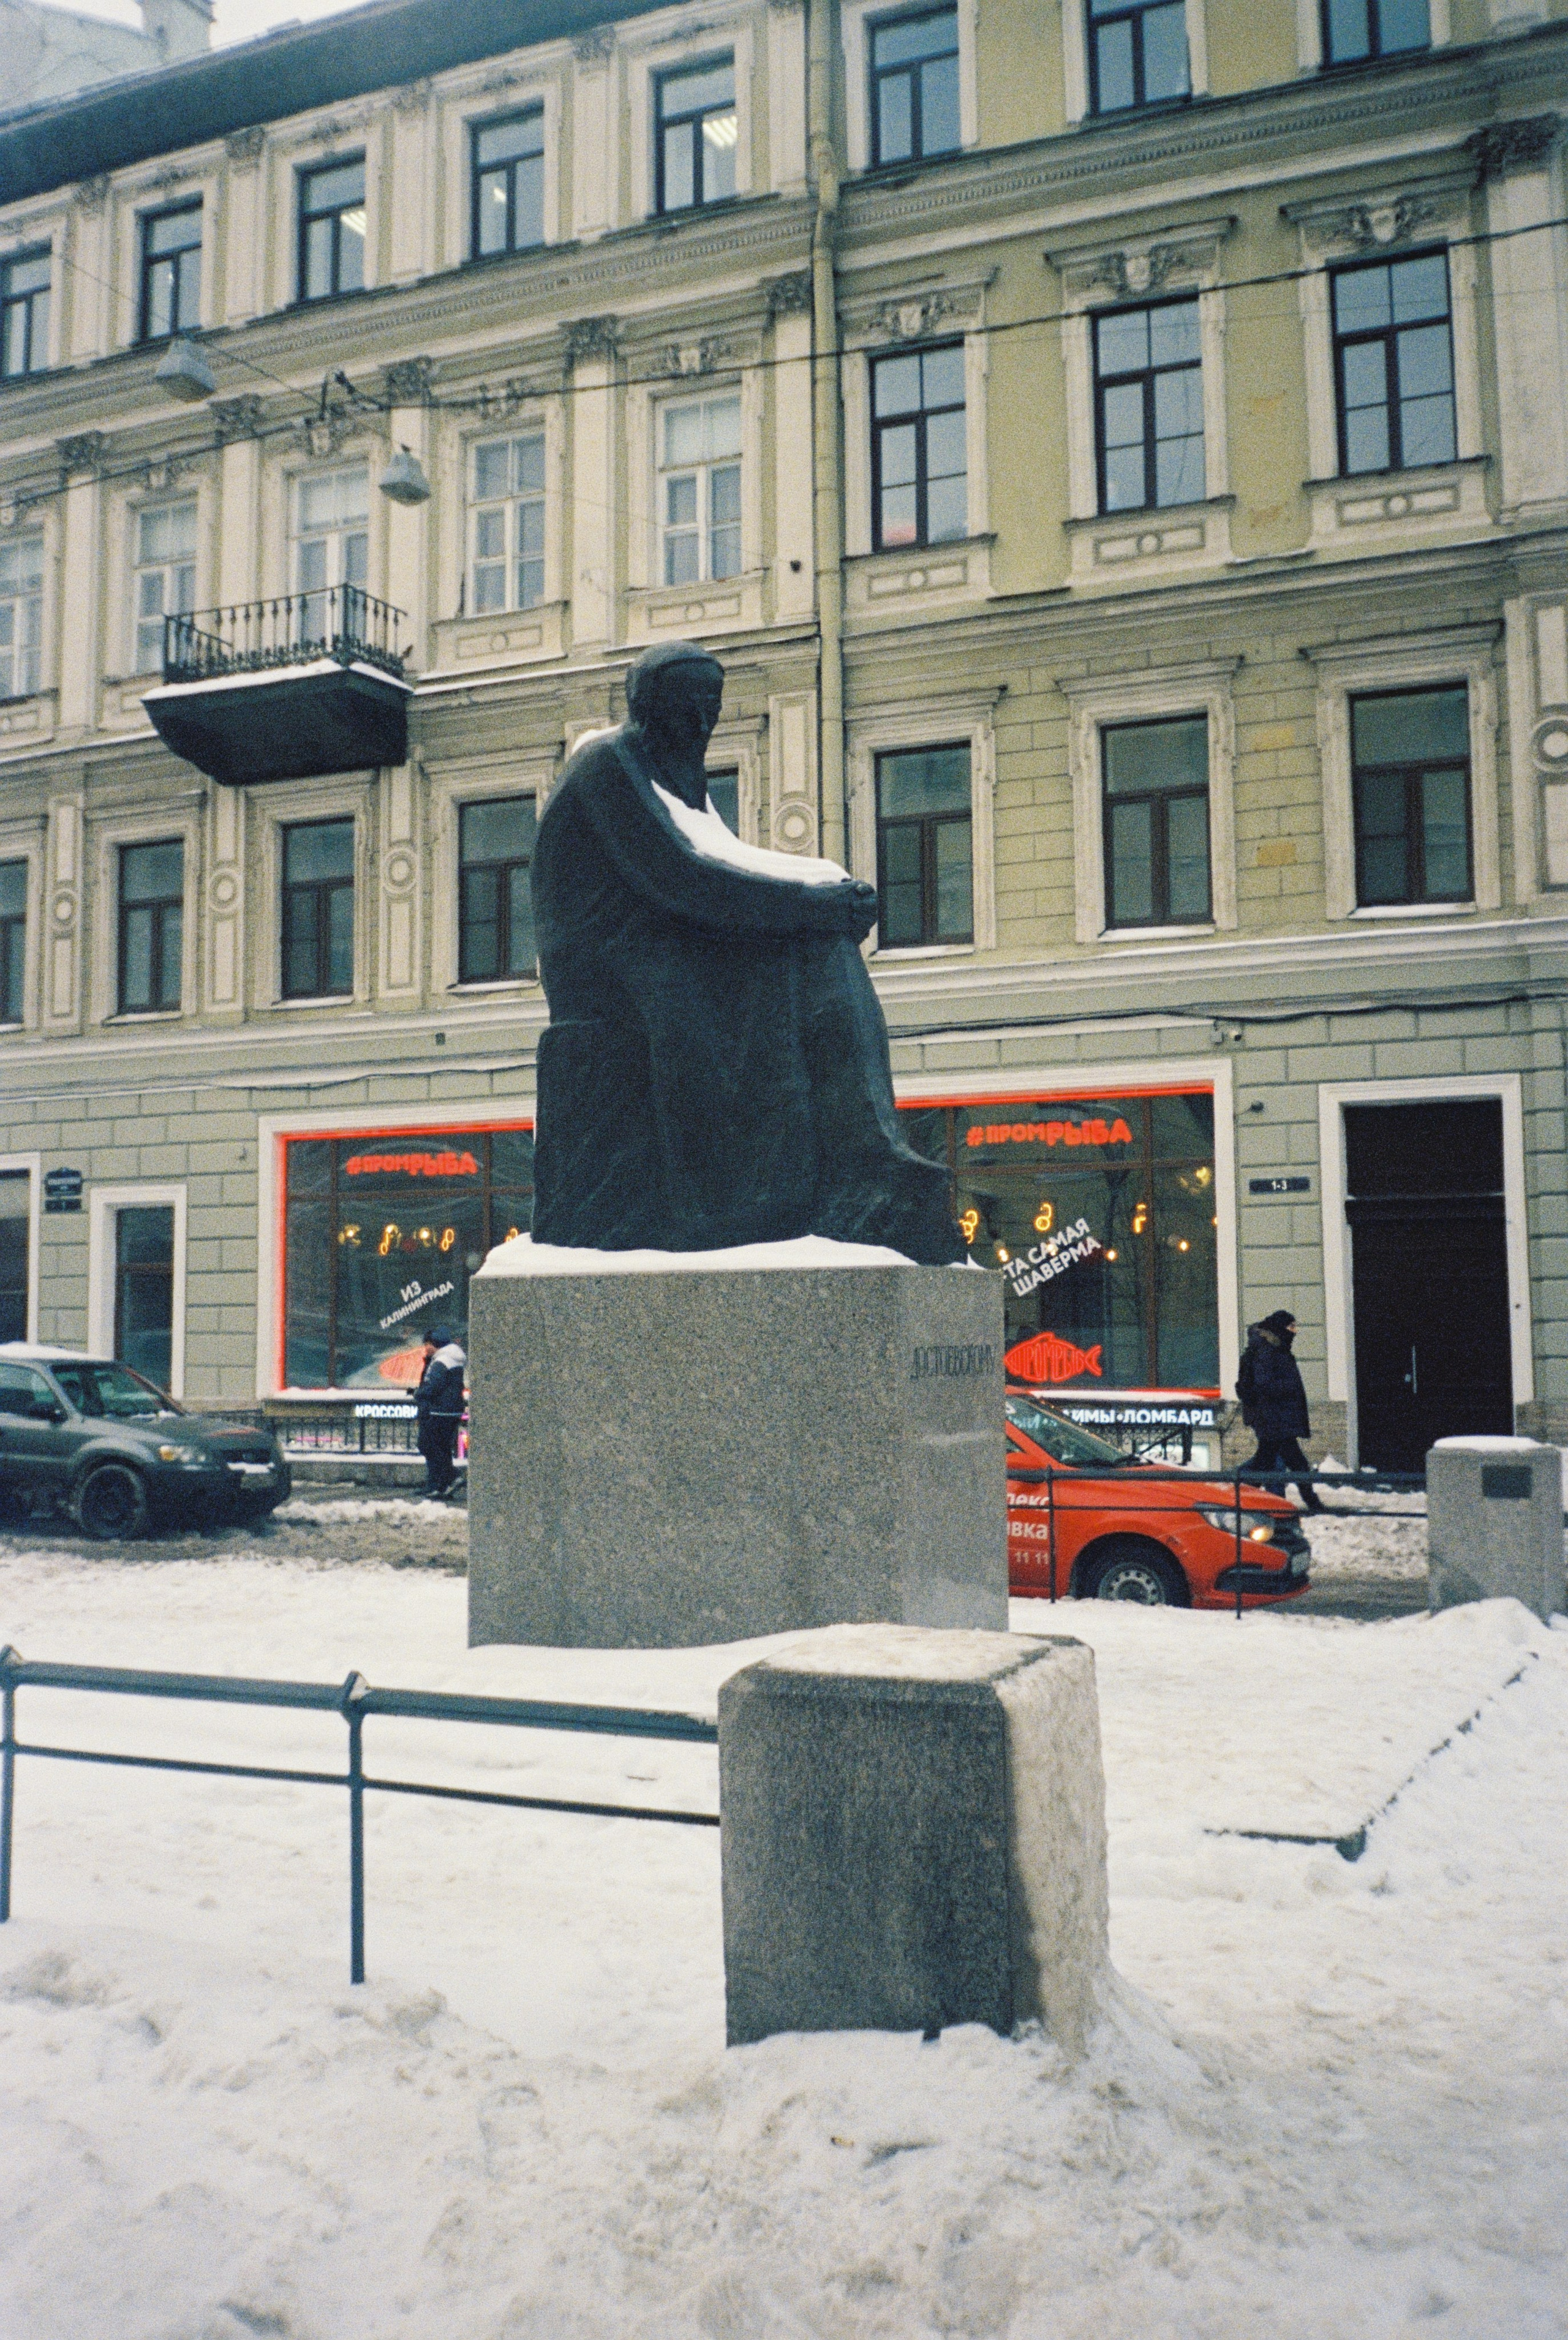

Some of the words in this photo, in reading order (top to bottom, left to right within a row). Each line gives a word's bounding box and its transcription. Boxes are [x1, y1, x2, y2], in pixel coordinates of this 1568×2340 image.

[1002, 1257, 1030, 1280] ТА
[1028, 1217, 1091, 1264] САМАЯ
[1012, 1236, 1102, 1297] ШАВЕРМА
[379, 1280, 454, 1329] КАЛИНИНГРАДА
[400, 1280, 422, 1302] ИЗ
